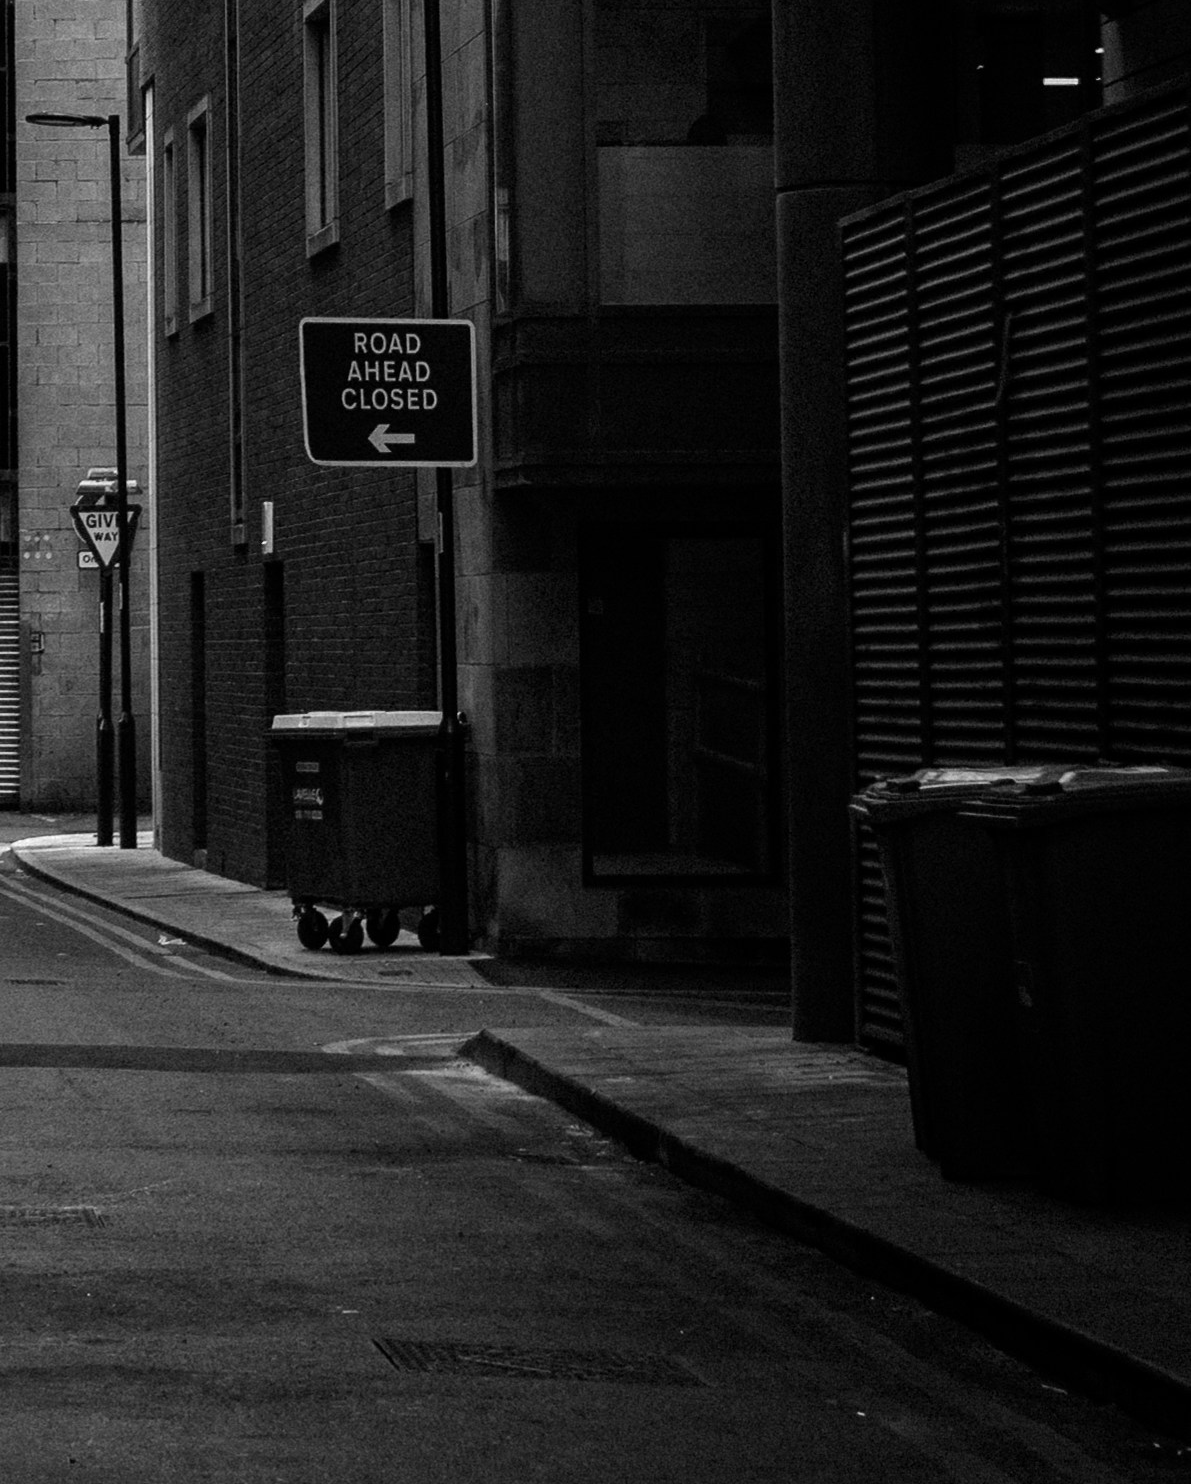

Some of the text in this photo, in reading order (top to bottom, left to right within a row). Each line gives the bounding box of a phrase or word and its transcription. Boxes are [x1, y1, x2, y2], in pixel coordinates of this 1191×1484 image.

[353, 332, 421, 354] ROAD
[347, 360, 431, 382] AHEAD
[341, 388, 438, 410] CLOSED
[93, 532, 118, 541] WAY
